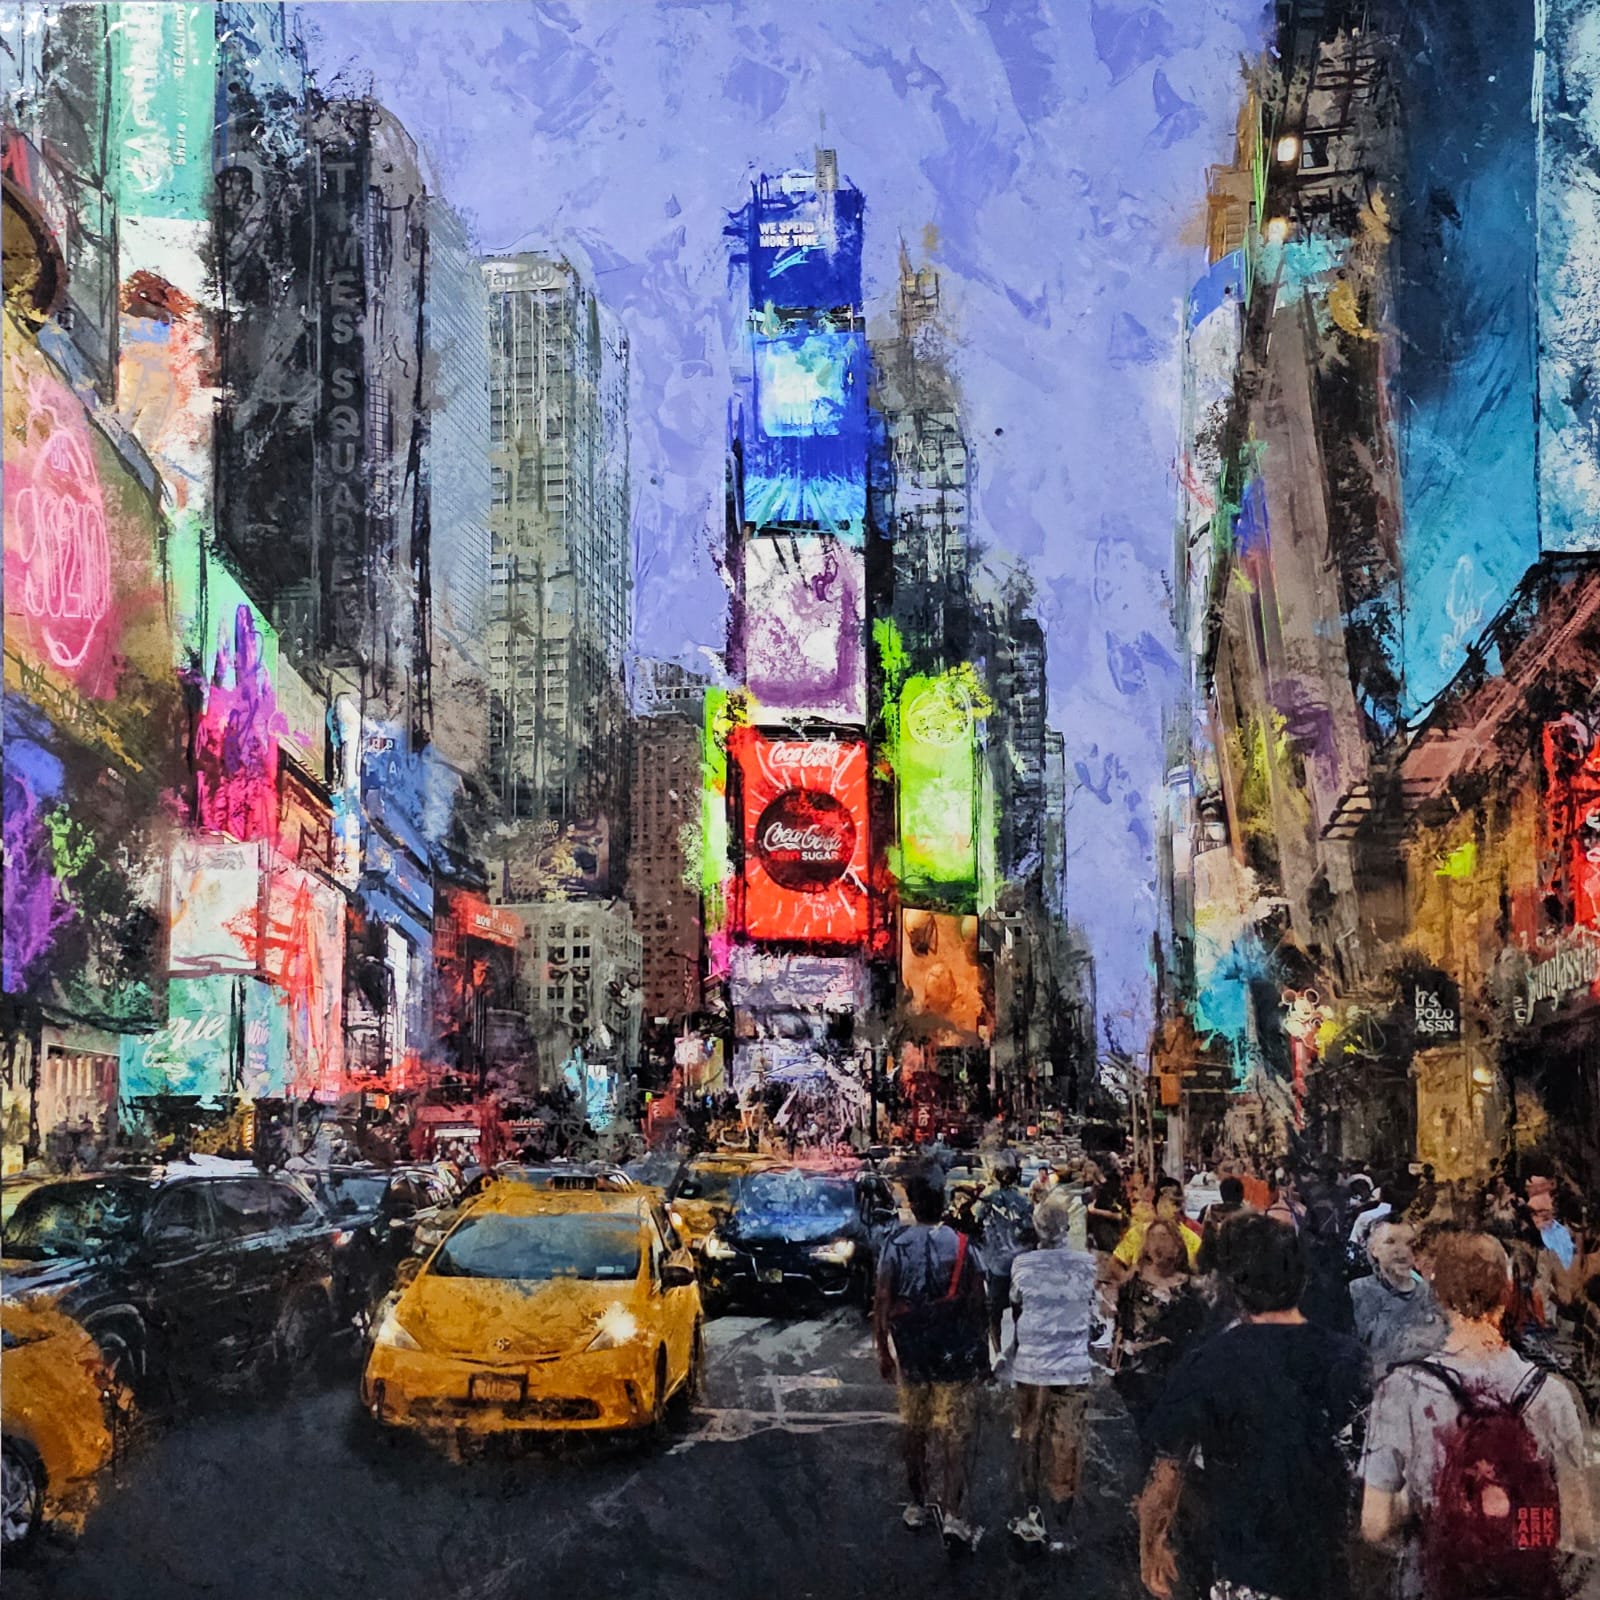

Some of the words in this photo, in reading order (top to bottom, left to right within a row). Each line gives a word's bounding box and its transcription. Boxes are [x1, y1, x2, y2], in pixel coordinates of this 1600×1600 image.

[172, 122, 187, 166] Share
[759, 223, 777, 235] WE
[779, 222, 814, 234] SPEND
[760, 235, 790, 247] MORE
[792, 235, 819, 247] TIME
[324, 162, 359, 345] TIMES
[328, 366, 361, 592] SQUARE
[801, 851, 839, 860] SUGAR
[1415, 1008, 1454, 1020] POLO
[1518, 1507, 1554, 1520] BEN
[1518, 1520, 1554, 1533] ARK
[1518, 1534, 1554, 1547] ART
